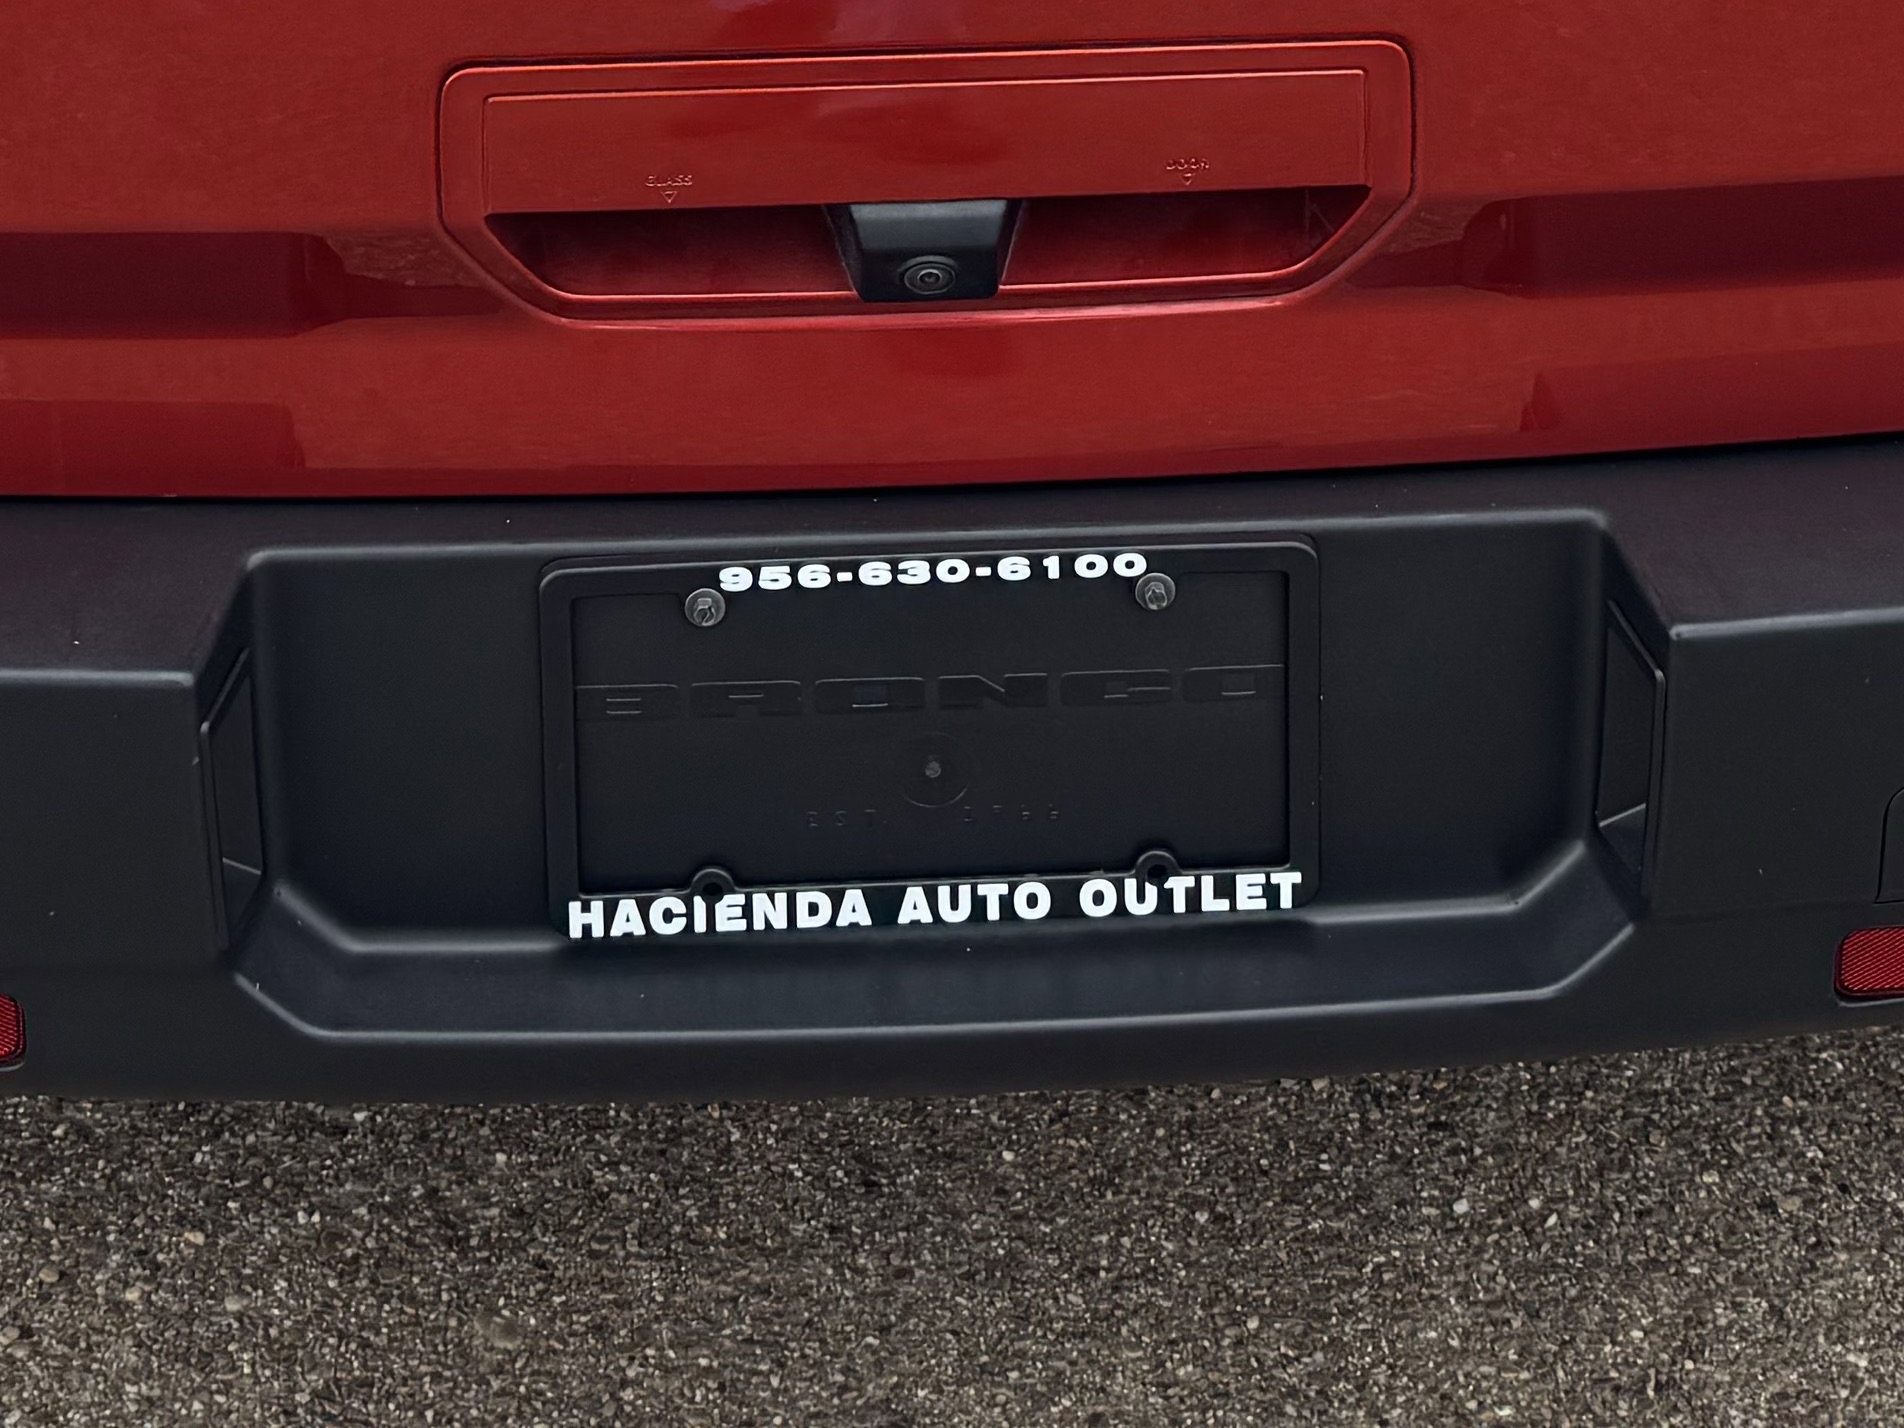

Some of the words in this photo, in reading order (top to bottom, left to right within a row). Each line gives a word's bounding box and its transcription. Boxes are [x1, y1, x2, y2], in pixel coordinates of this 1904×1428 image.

[718, 552, 1148, 593] 956-630-6100
[574, 664, 1284, 721] BRONCO
[568, 889, 873, 938] HACIENDA
[897, 880, 1052, 924] AUTO
[1079, 871, 1302, 917] OUTLET
